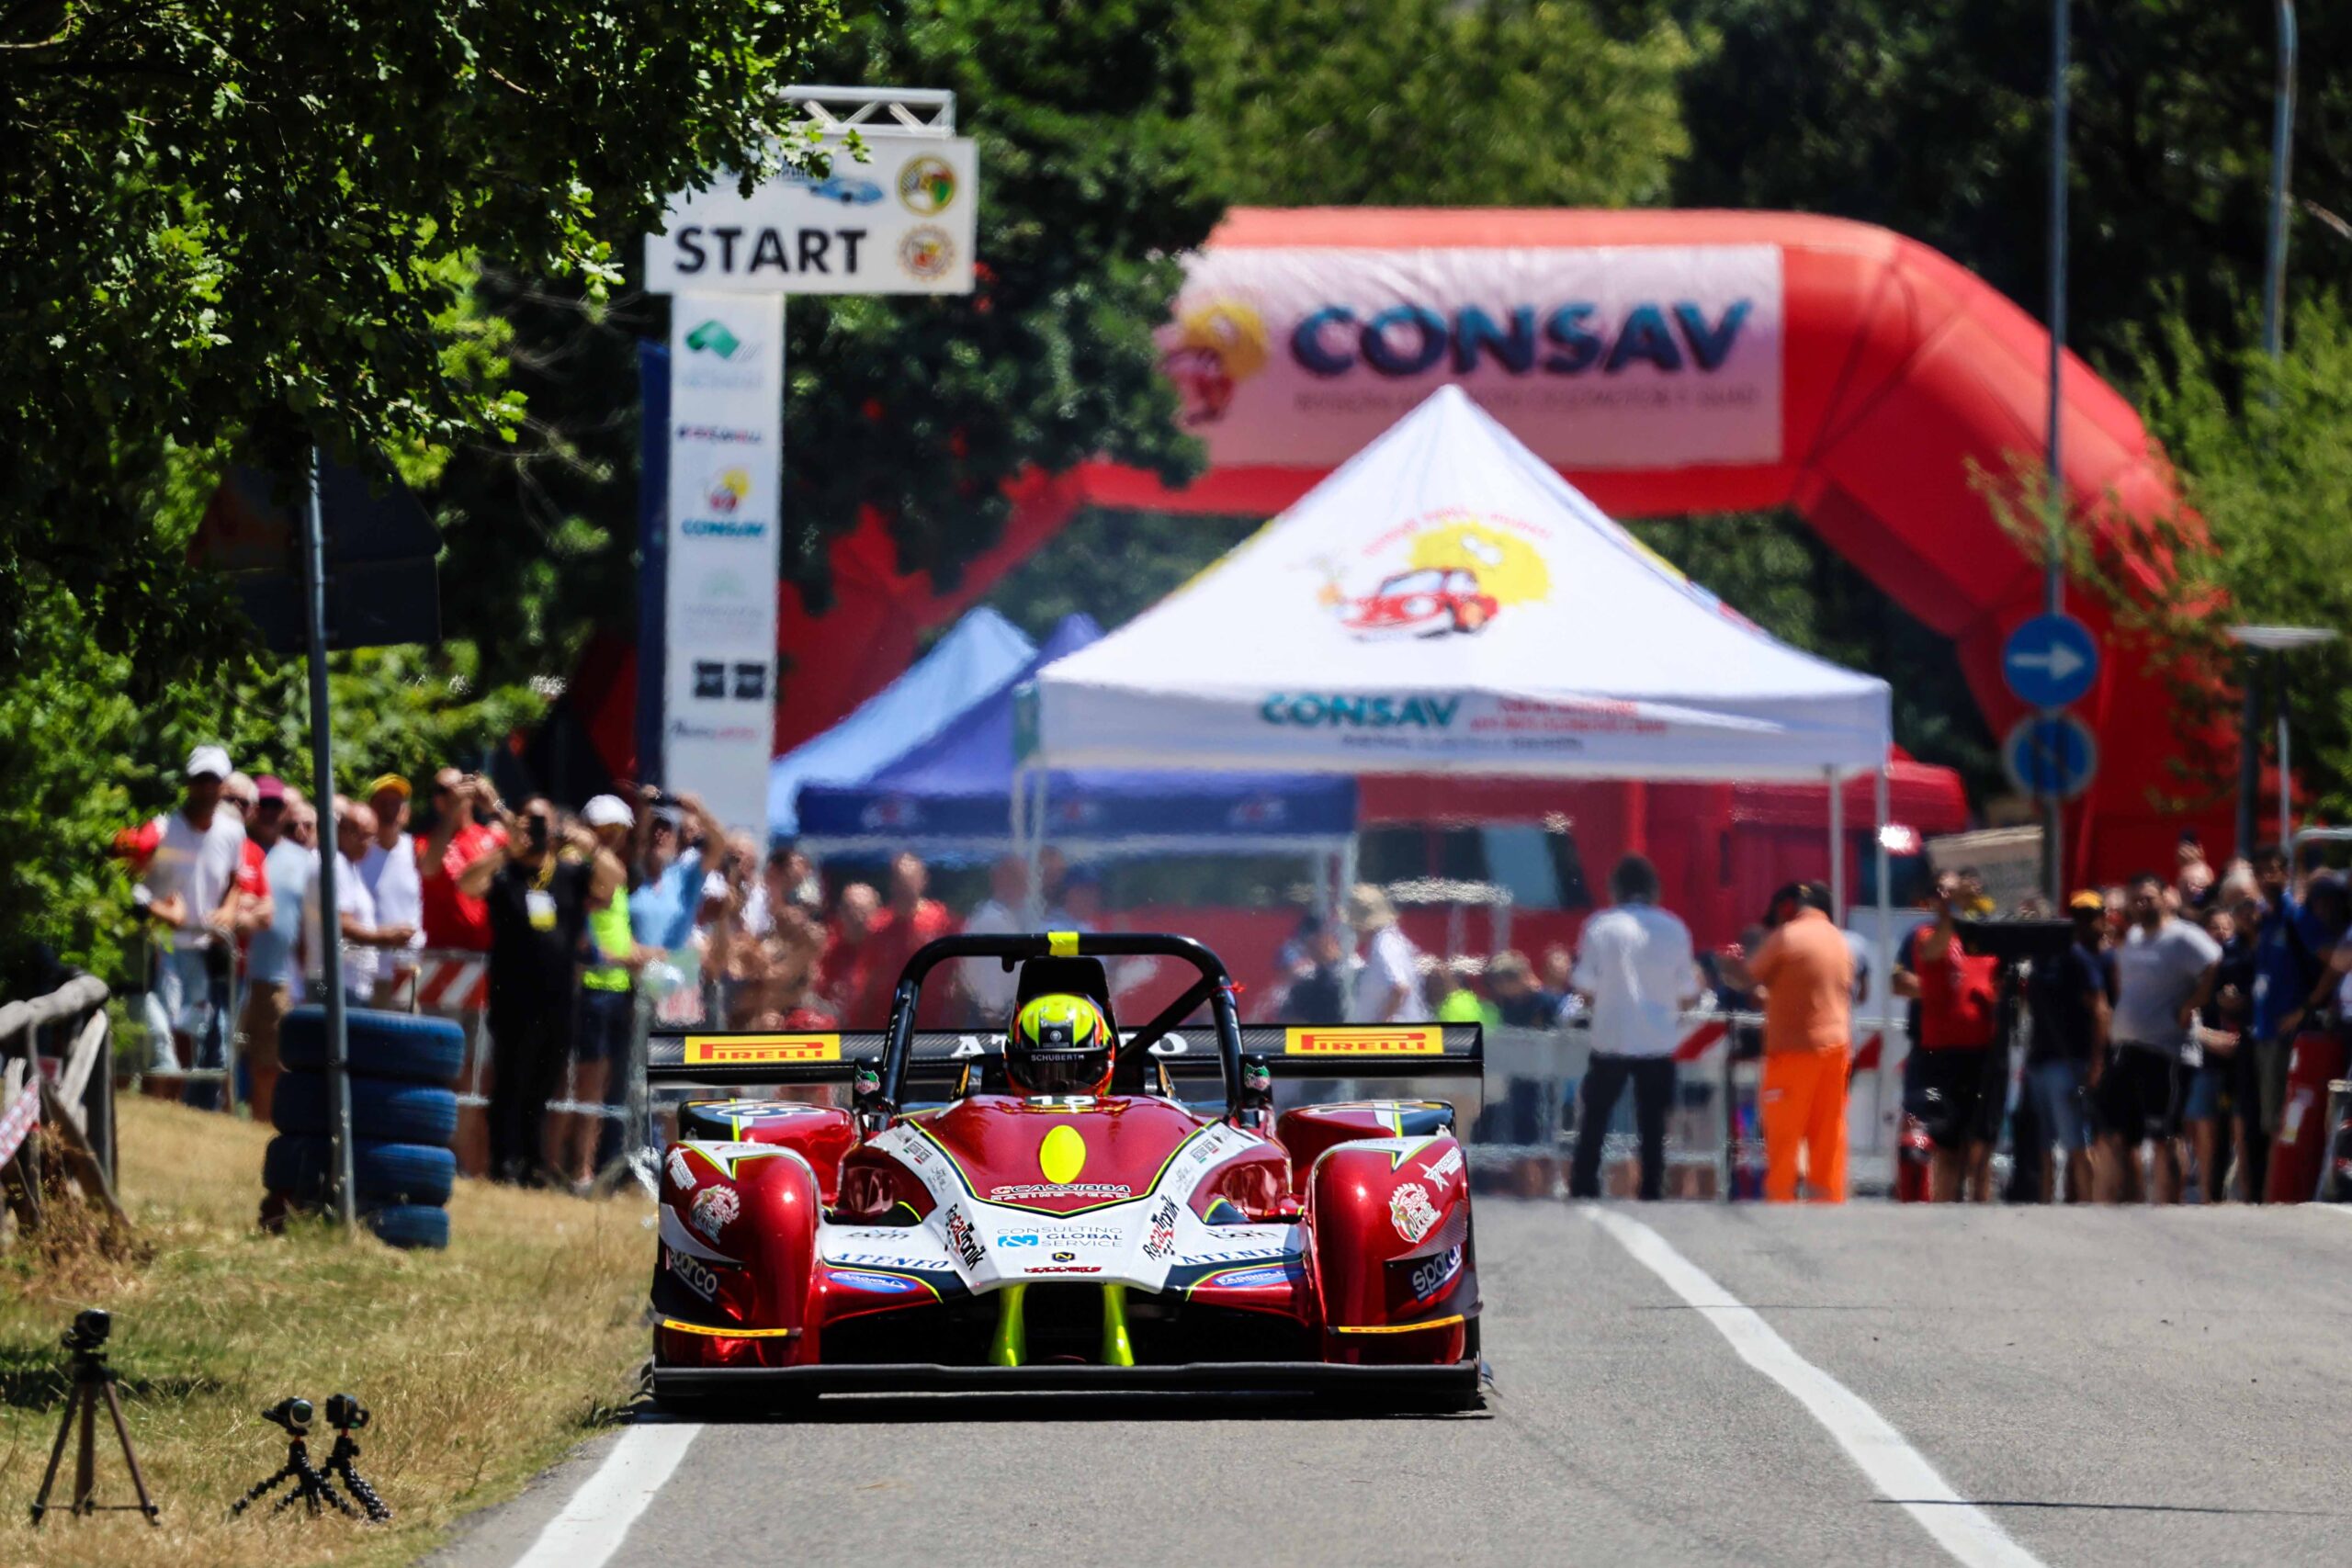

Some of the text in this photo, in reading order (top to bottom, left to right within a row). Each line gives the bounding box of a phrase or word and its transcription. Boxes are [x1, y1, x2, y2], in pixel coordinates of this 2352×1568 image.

[675, 226, 867, 274] START
[1289, 299, 1754, 378] CONSAV
[1260, 691, 1460, 728] CONSAV
[1300, 1032, 1427, 1051] PIRELLI
[699, 1042, 824, 1060] PIRELLI
[997, 1226, 1123, 1235] CONSULTING
[831, 1252, 950, 1269] ATENEO
[1180, 1247, 1297, 1265] ATENEO
